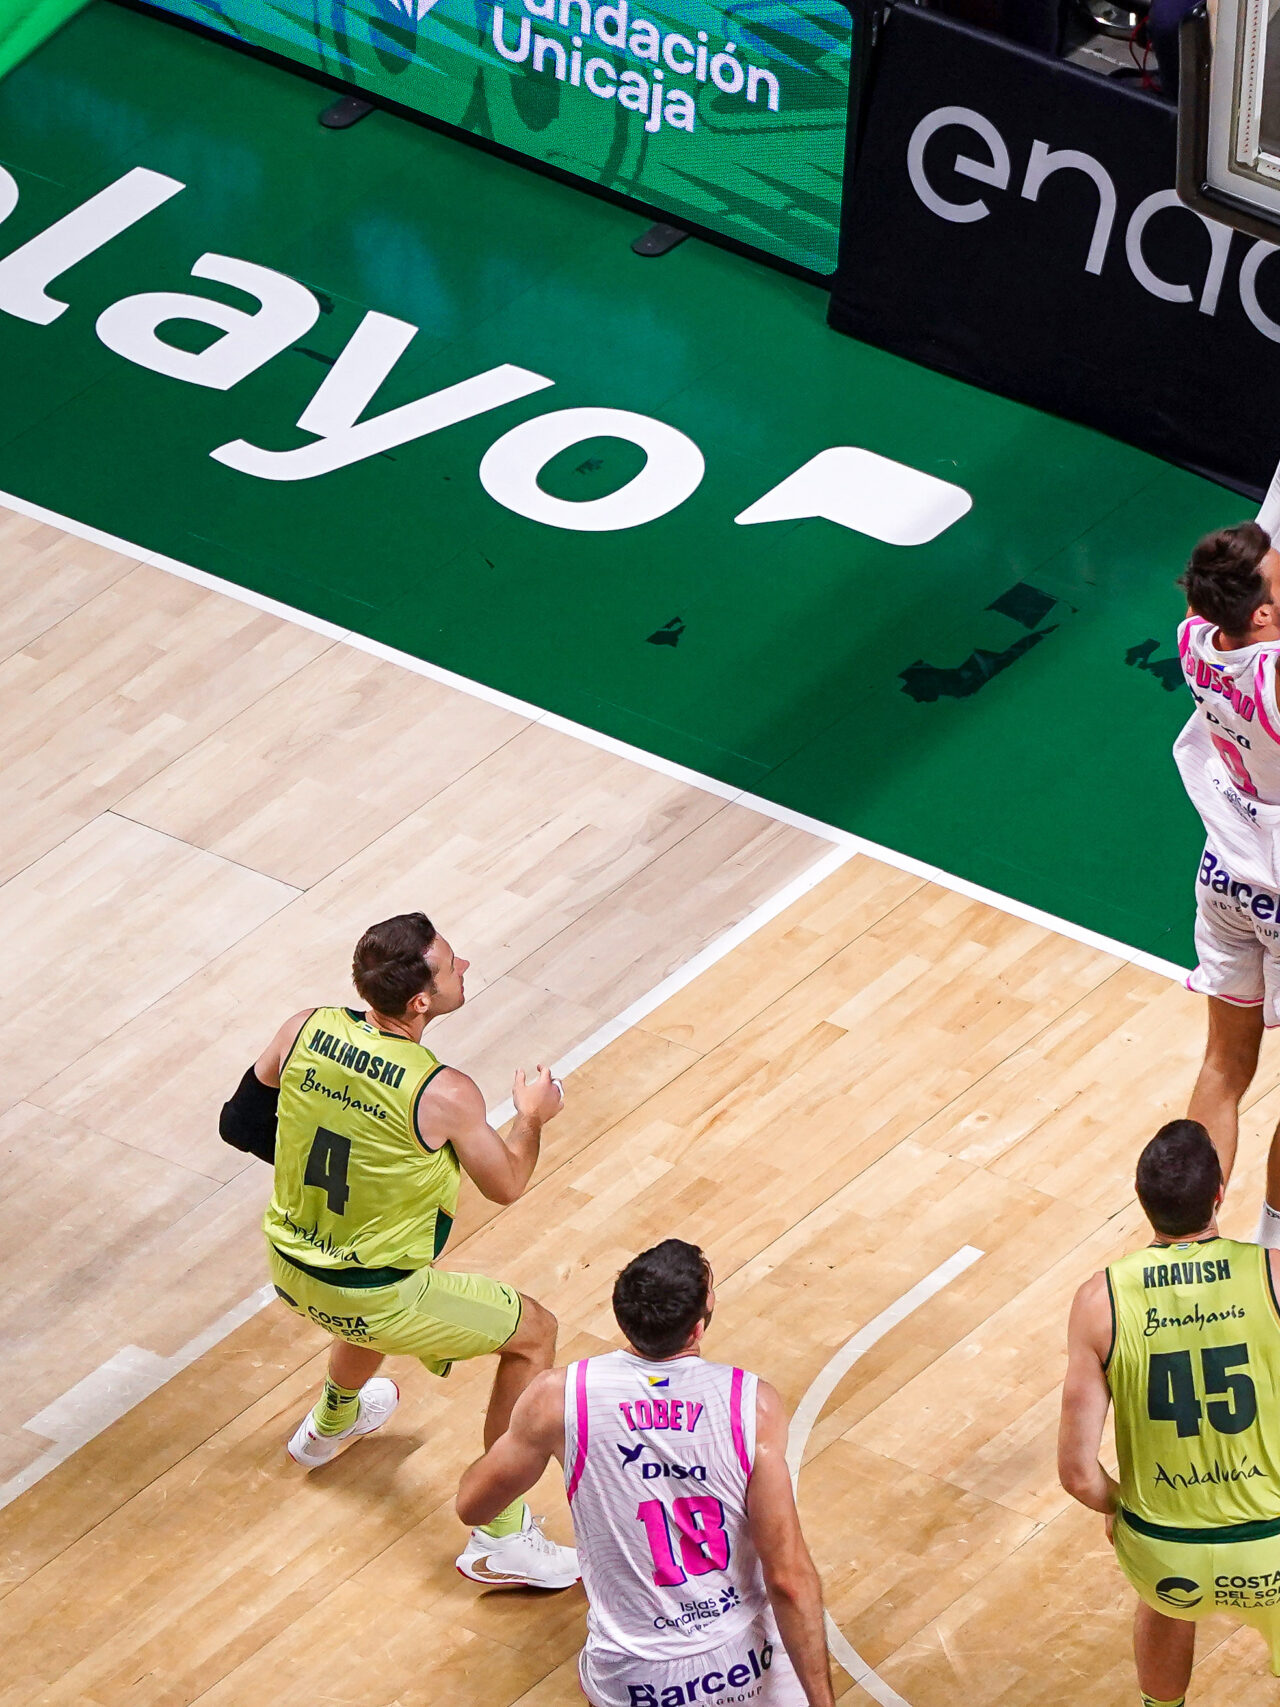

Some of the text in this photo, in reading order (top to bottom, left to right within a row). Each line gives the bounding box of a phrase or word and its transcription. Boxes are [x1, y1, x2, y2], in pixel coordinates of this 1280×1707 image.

[492, 5, 696, 133] Unicaja
[523, 0, 779, 112] undación
[0, 166, 705, 531] layo
[308, 1028, 406, 1089] KALINOSKI
[303, 1126, 352, 1217] 4
[1142, 1259, 1232, 1289] KRAVISH
[307, 1305, 370, 1329] COSTA
[1147, 1342, 1257, 1438] 45
[618, 1399, 704, 1432] TOBEY
[1153, 1455, 1270, 1491] Andalucía
[635, 1495, 732, 1588] 18
[653, 1607, 721, 1630] Canarias
[679, 1597, 718, 1613] Islas
[1215, 1590, 1250, 1600] DEL
